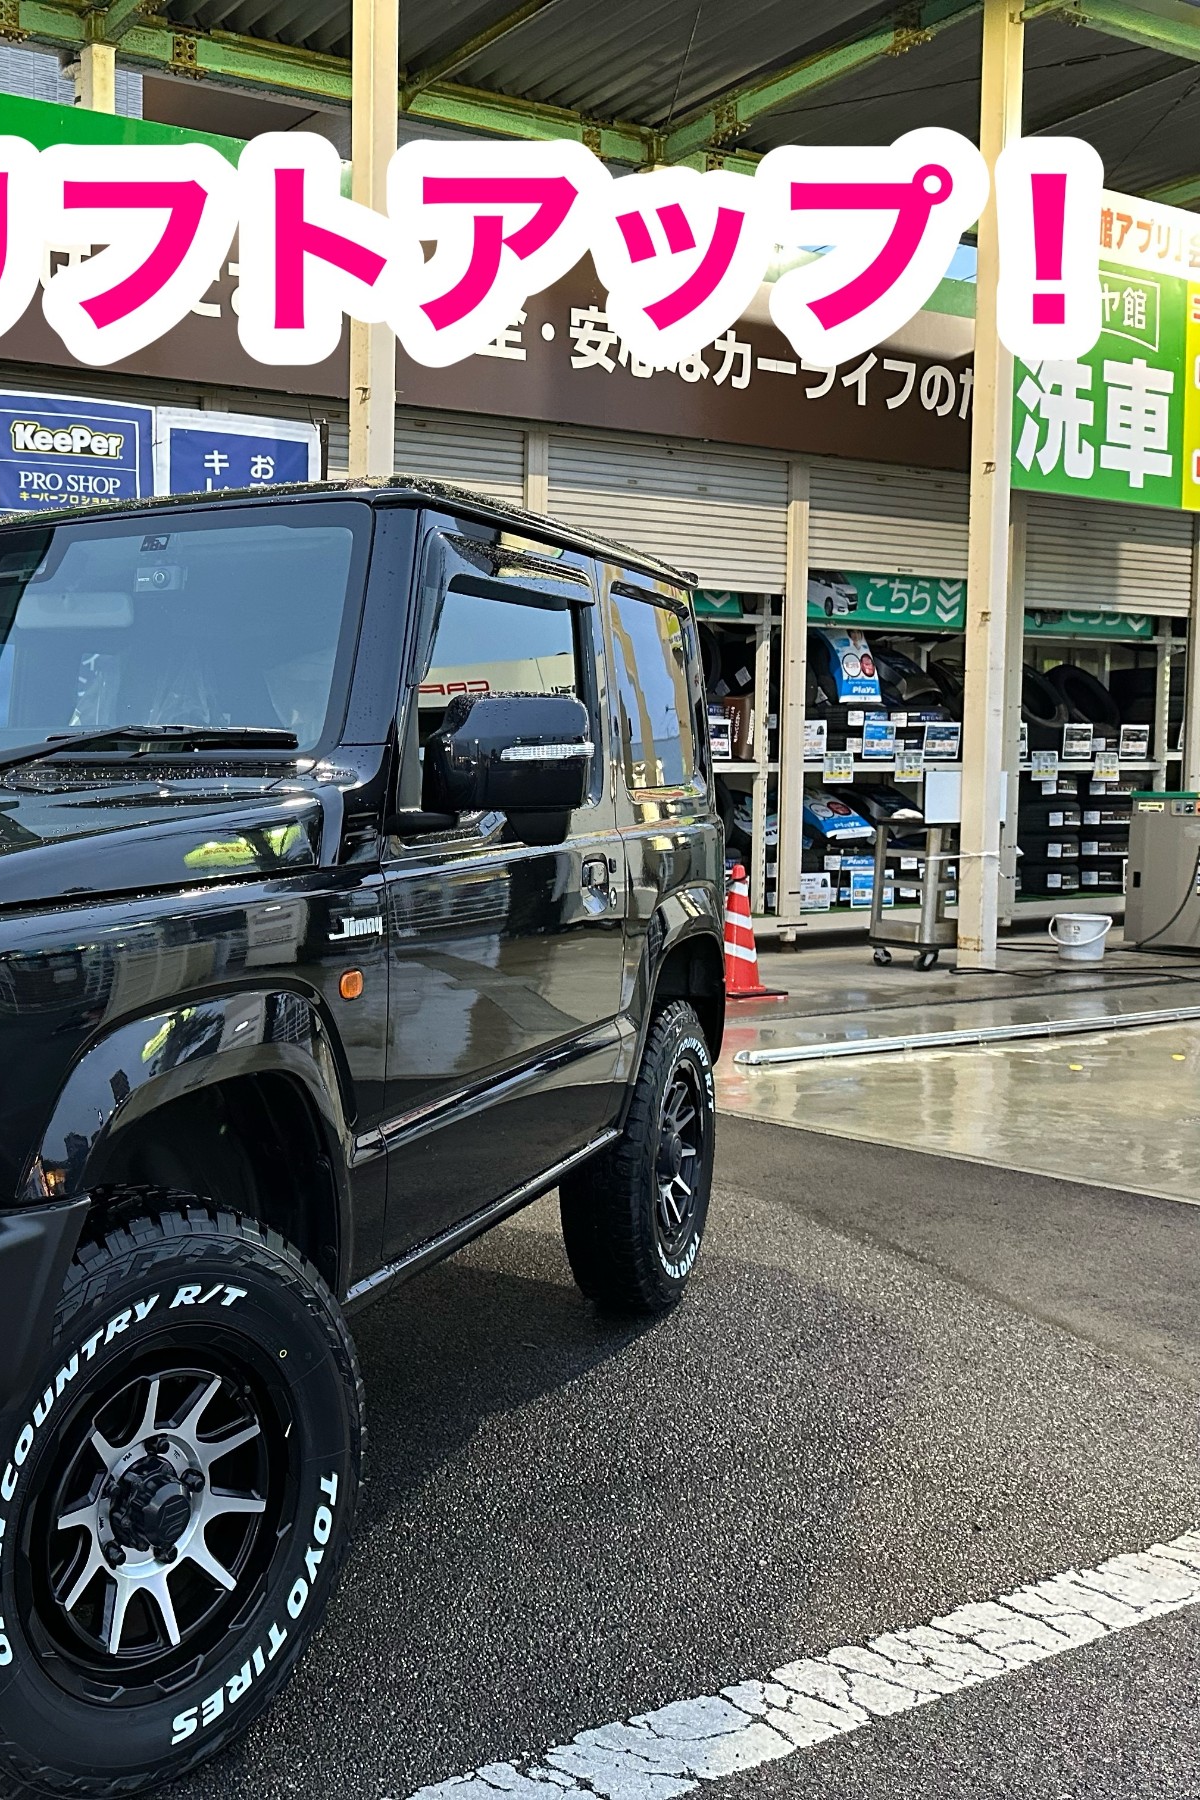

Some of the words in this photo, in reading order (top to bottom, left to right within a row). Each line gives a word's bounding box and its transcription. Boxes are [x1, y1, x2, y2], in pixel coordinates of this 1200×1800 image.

[11, 419, 122, 459] KeePer
[1015, 358, 1175, 489] 洗車
[19, 471, 63, 491] PRO
[66, 474, 121, 495] SHOP
[249, 455, 275, 488] お
[865, 578, 931, 615] こちら
[328, 916, 383, 940] Jimny
[0, 1295, 160, 1502] COUNTRY
[169, 1282, 248, 1310] R/T
[286, 1472, 339, 1621] TOYO
[170, 1622, 290, 1746] TIRES
